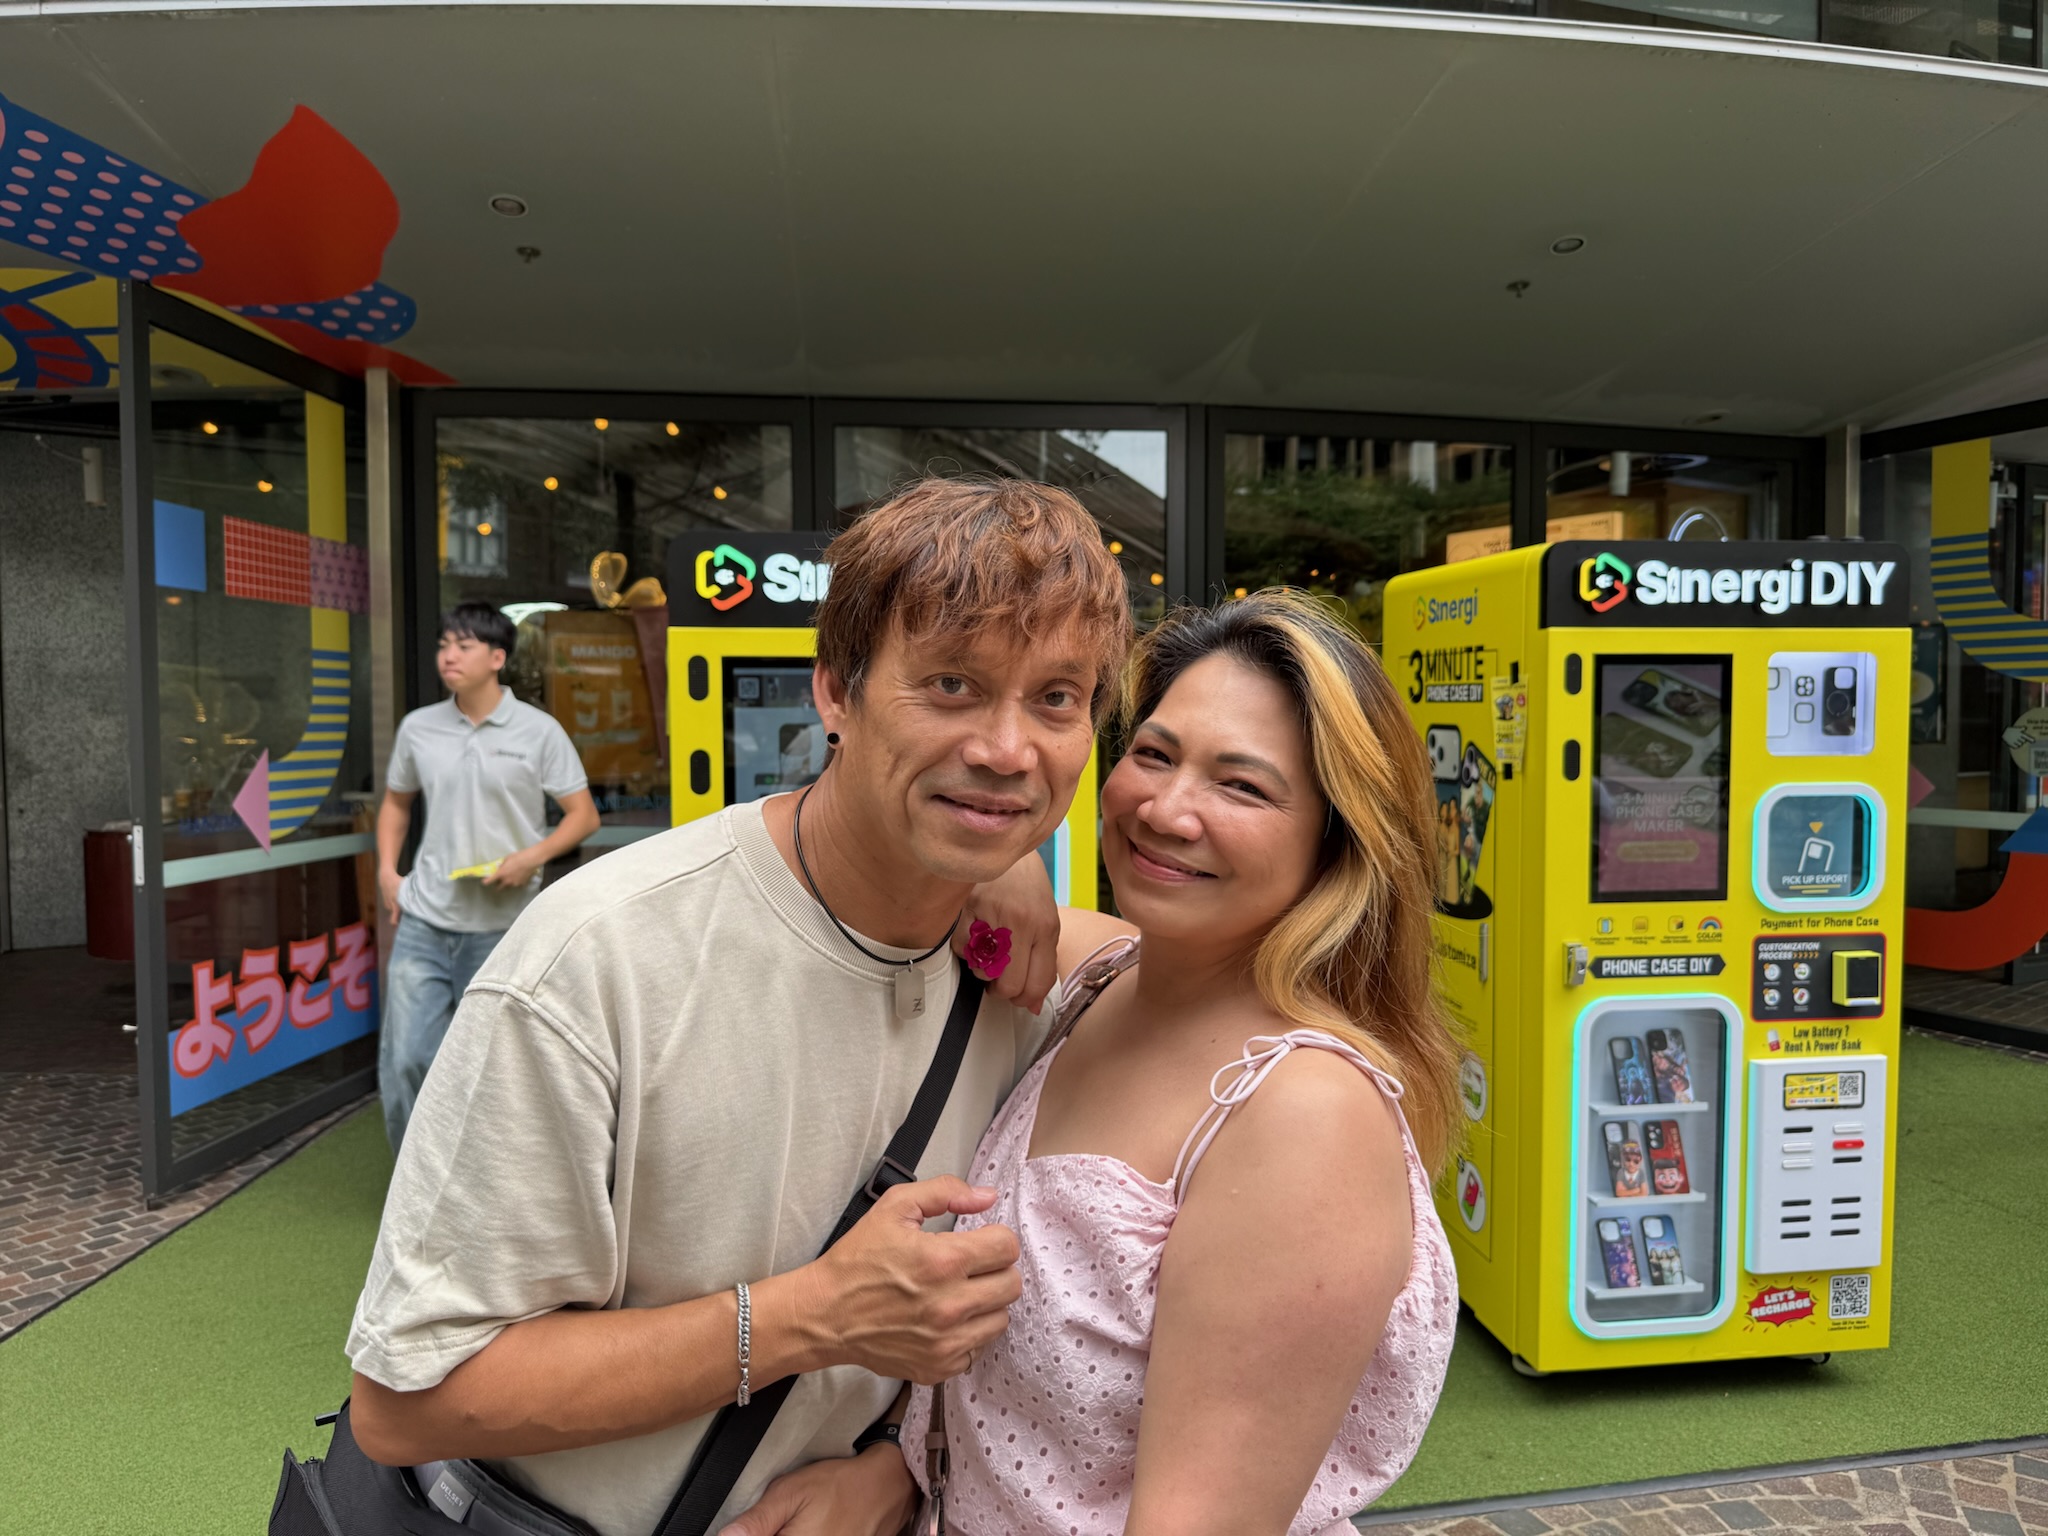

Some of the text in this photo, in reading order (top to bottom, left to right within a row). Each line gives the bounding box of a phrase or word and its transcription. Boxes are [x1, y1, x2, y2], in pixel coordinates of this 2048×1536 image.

[1635, 558, 1897, 615] Sinergi DIY
[1428, 588, 1479, 625] Sinergi
[571, 644, 637, 659] MANGO
[1409, 645, 1484, 703] 3 MINUTE
[1427, 684, 1482, 701] PHONE CASE DIY
[1616, 805, 1703, 819] PHONE CASE
[1633, 820, 1684, 832] MAKER
[1782, 874, 1849, 885] PICK UP EXPORT
[1760, 916, 1879, 931] Payment for Phone Case
[1758, 942, 1820, 952] CUSTOMIZATION
[1758, 951, 1793, 960] PROCESS
[1602, 957, 1713, 976] PHONE CASE DIY
[174, 920, 380, 1078] ようこそ
[1793, 1027, 1809, 1038] Low
[1812, 1026, 1843, 1038] Battery
[1784, 1038, 1862, 1052] Rent A Power Bank
[1764, 1289, 1796, 1305] LET'S
[1751, 1298, 1811, 1318] RECHARGE
[440, 1481, 464, 1507] DELSEY
